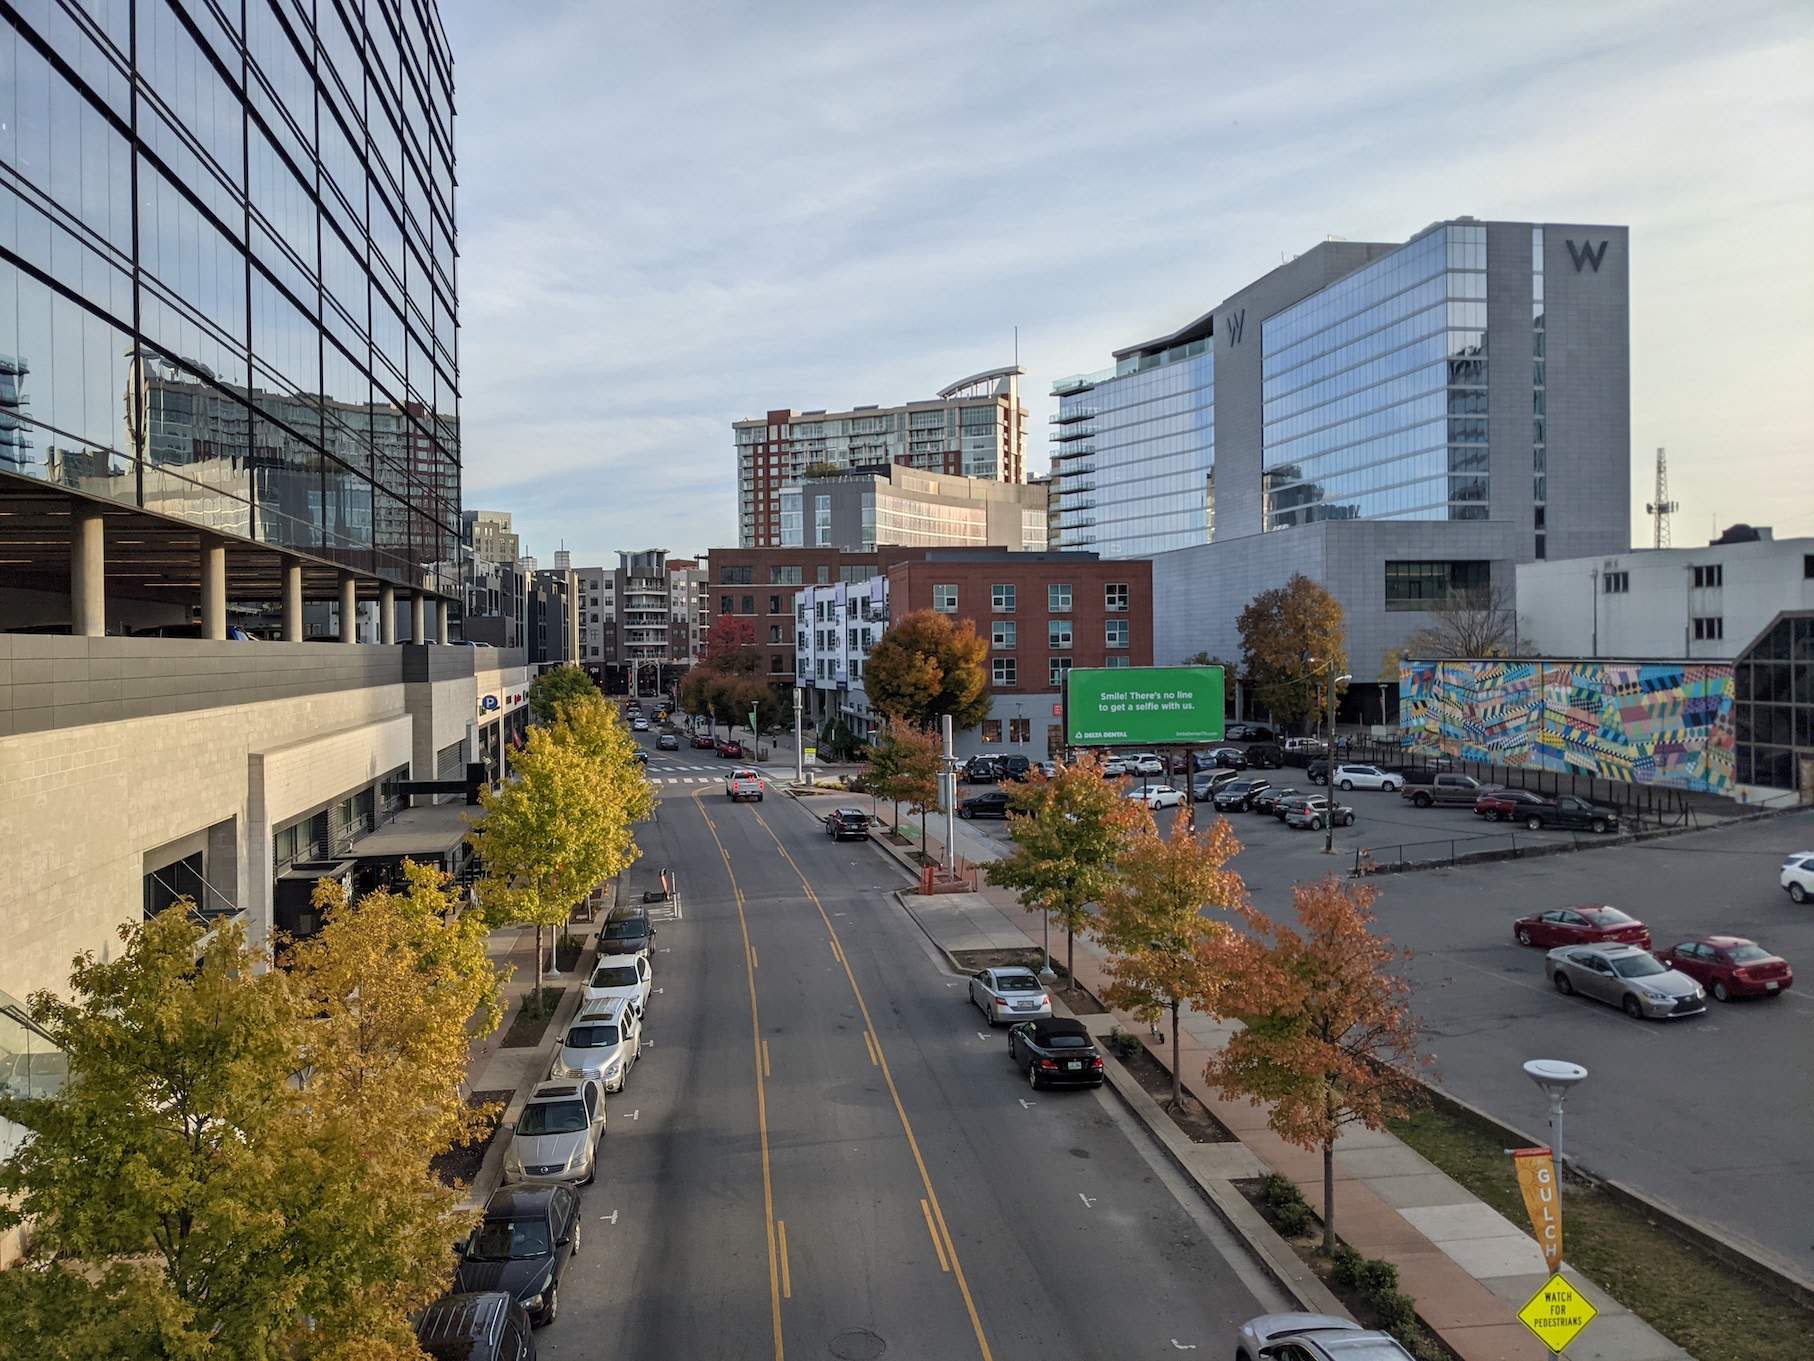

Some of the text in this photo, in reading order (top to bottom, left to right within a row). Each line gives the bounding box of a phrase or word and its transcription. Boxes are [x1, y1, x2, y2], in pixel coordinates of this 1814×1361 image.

[1566, 240, 1608, 273] W
[1227, 308, 1245, 347] W
[1100, 691, 1193, 700] Smile! There's no line
[1099, 703, 1109, 711] to
[1111, 703, 1126, 713] get
[1136, 702, 1159, 711] selfie
[1161, 702, 1180, 711] with
[1538, 1169, 1557, 1257] GULCH
[1544, 1292, 1572, 1303] WATCH
[1550, 1304, 1566, 1315] FOR
[1534, 1316, 1583, 1328] PEDESTRIANS
